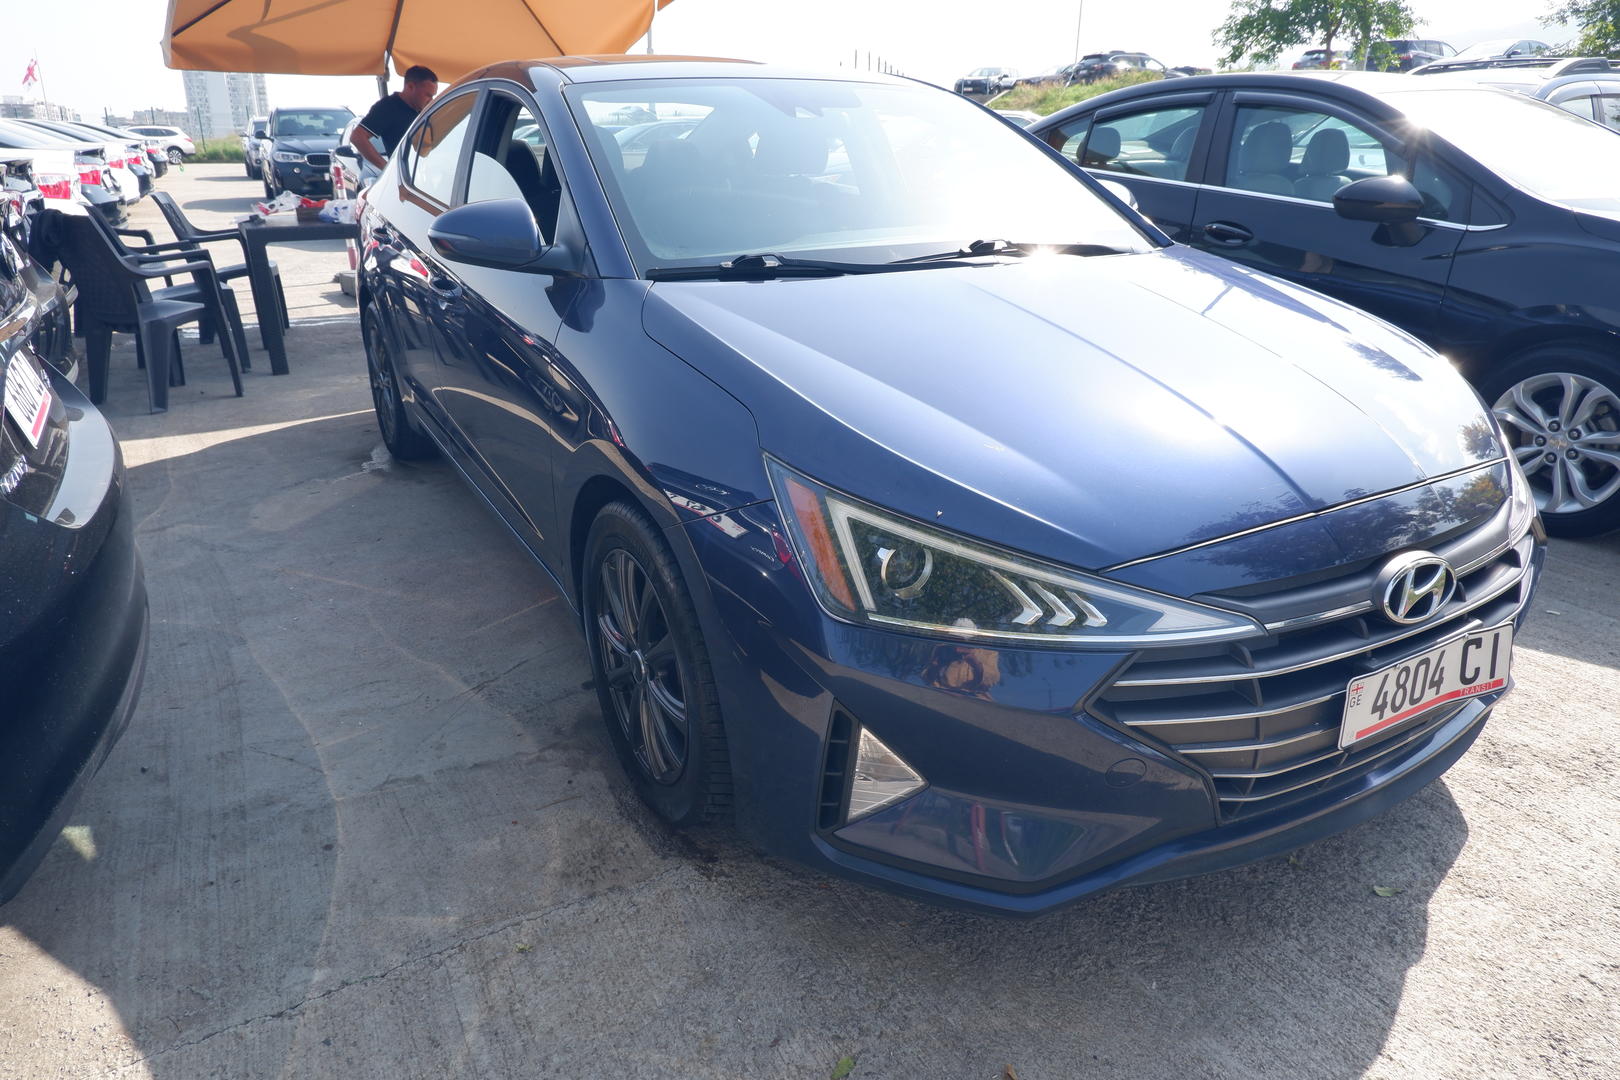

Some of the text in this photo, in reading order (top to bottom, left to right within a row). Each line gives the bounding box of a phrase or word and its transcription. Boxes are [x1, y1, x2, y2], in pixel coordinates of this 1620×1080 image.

[1371, 632, 1500, 721] 4804 CI
[1459, 682, 1495, 696] TRANSIT
[1349, 694, 1362, 708] GE
